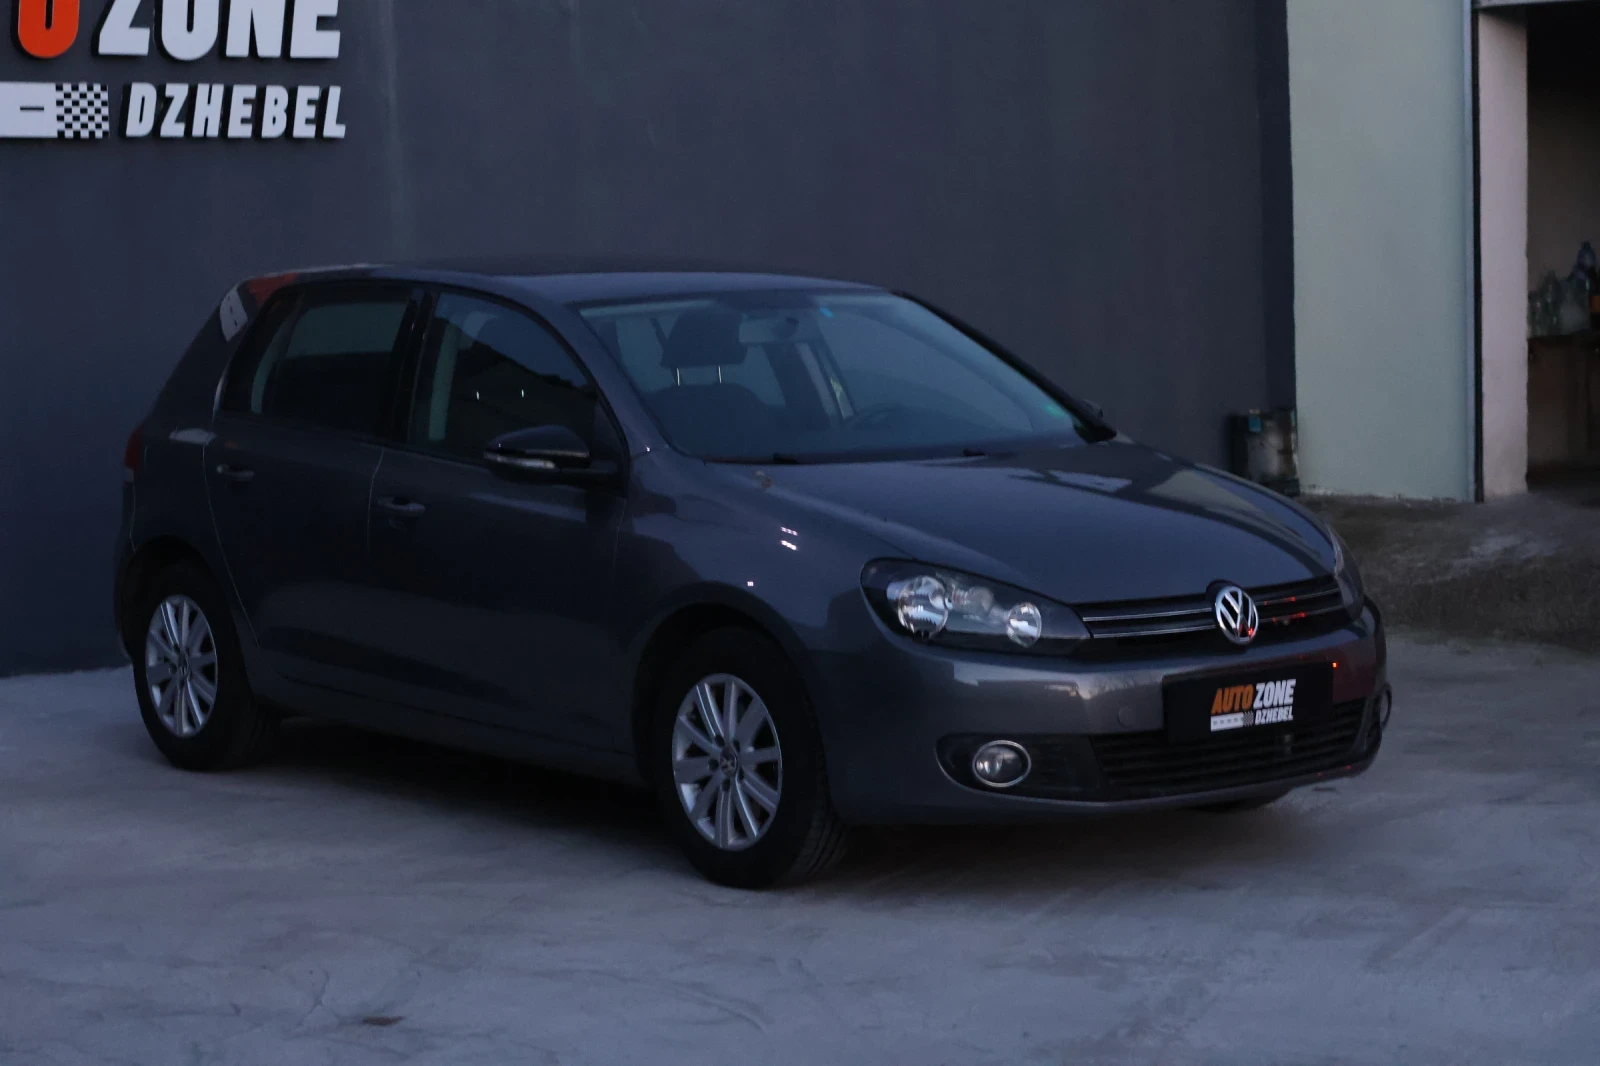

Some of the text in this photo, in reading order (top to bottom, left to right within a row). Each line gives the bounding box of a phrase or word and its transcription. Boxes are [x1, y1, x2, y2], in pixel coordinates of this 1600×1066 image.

[98, 0, 341, 61] ZONE
[125, 82, 346, 139] DZHEBEL
[1211, 678, 1297, 716] AUTO ZONE
[1254, 705, 1294, 726] DZHEBEL
